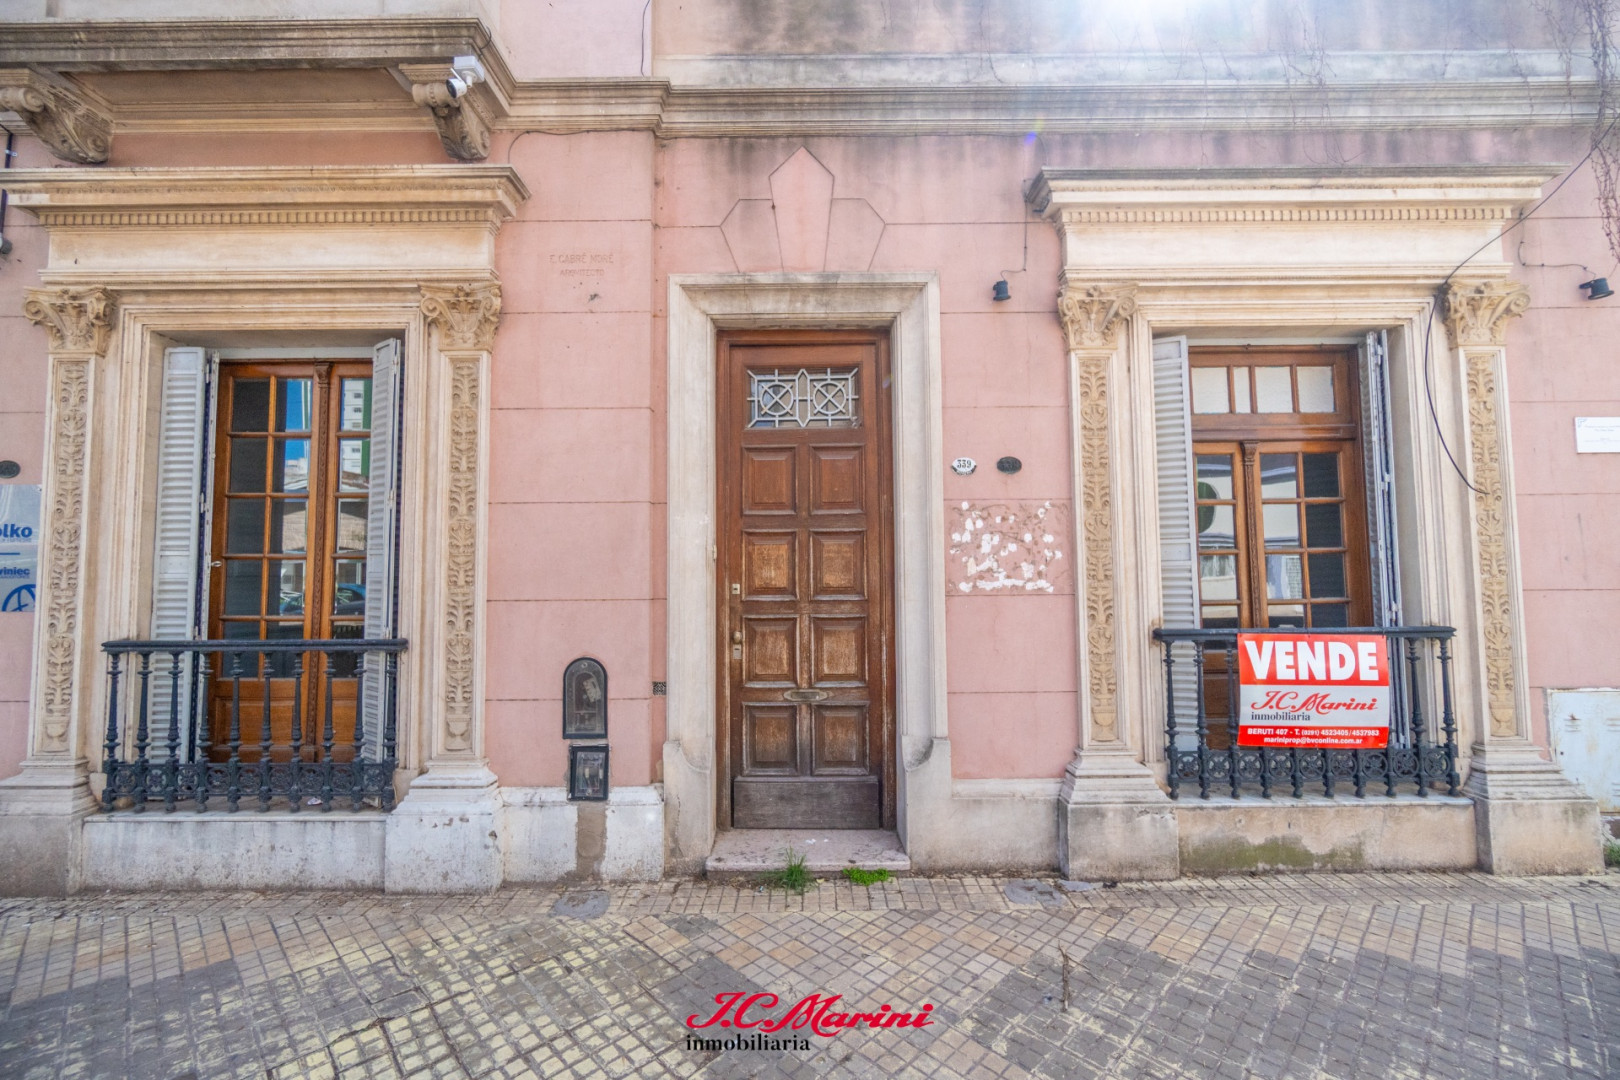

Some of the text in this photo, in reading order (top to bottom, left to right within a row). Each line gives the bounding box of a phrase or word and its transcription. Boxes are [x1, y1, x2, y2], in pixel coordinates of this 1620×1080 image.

[957, 459, 971, 468] 339
[1244, 640, 1379, 680] VENDE
[1251, 711, 1311, 721] inmobiliaria
